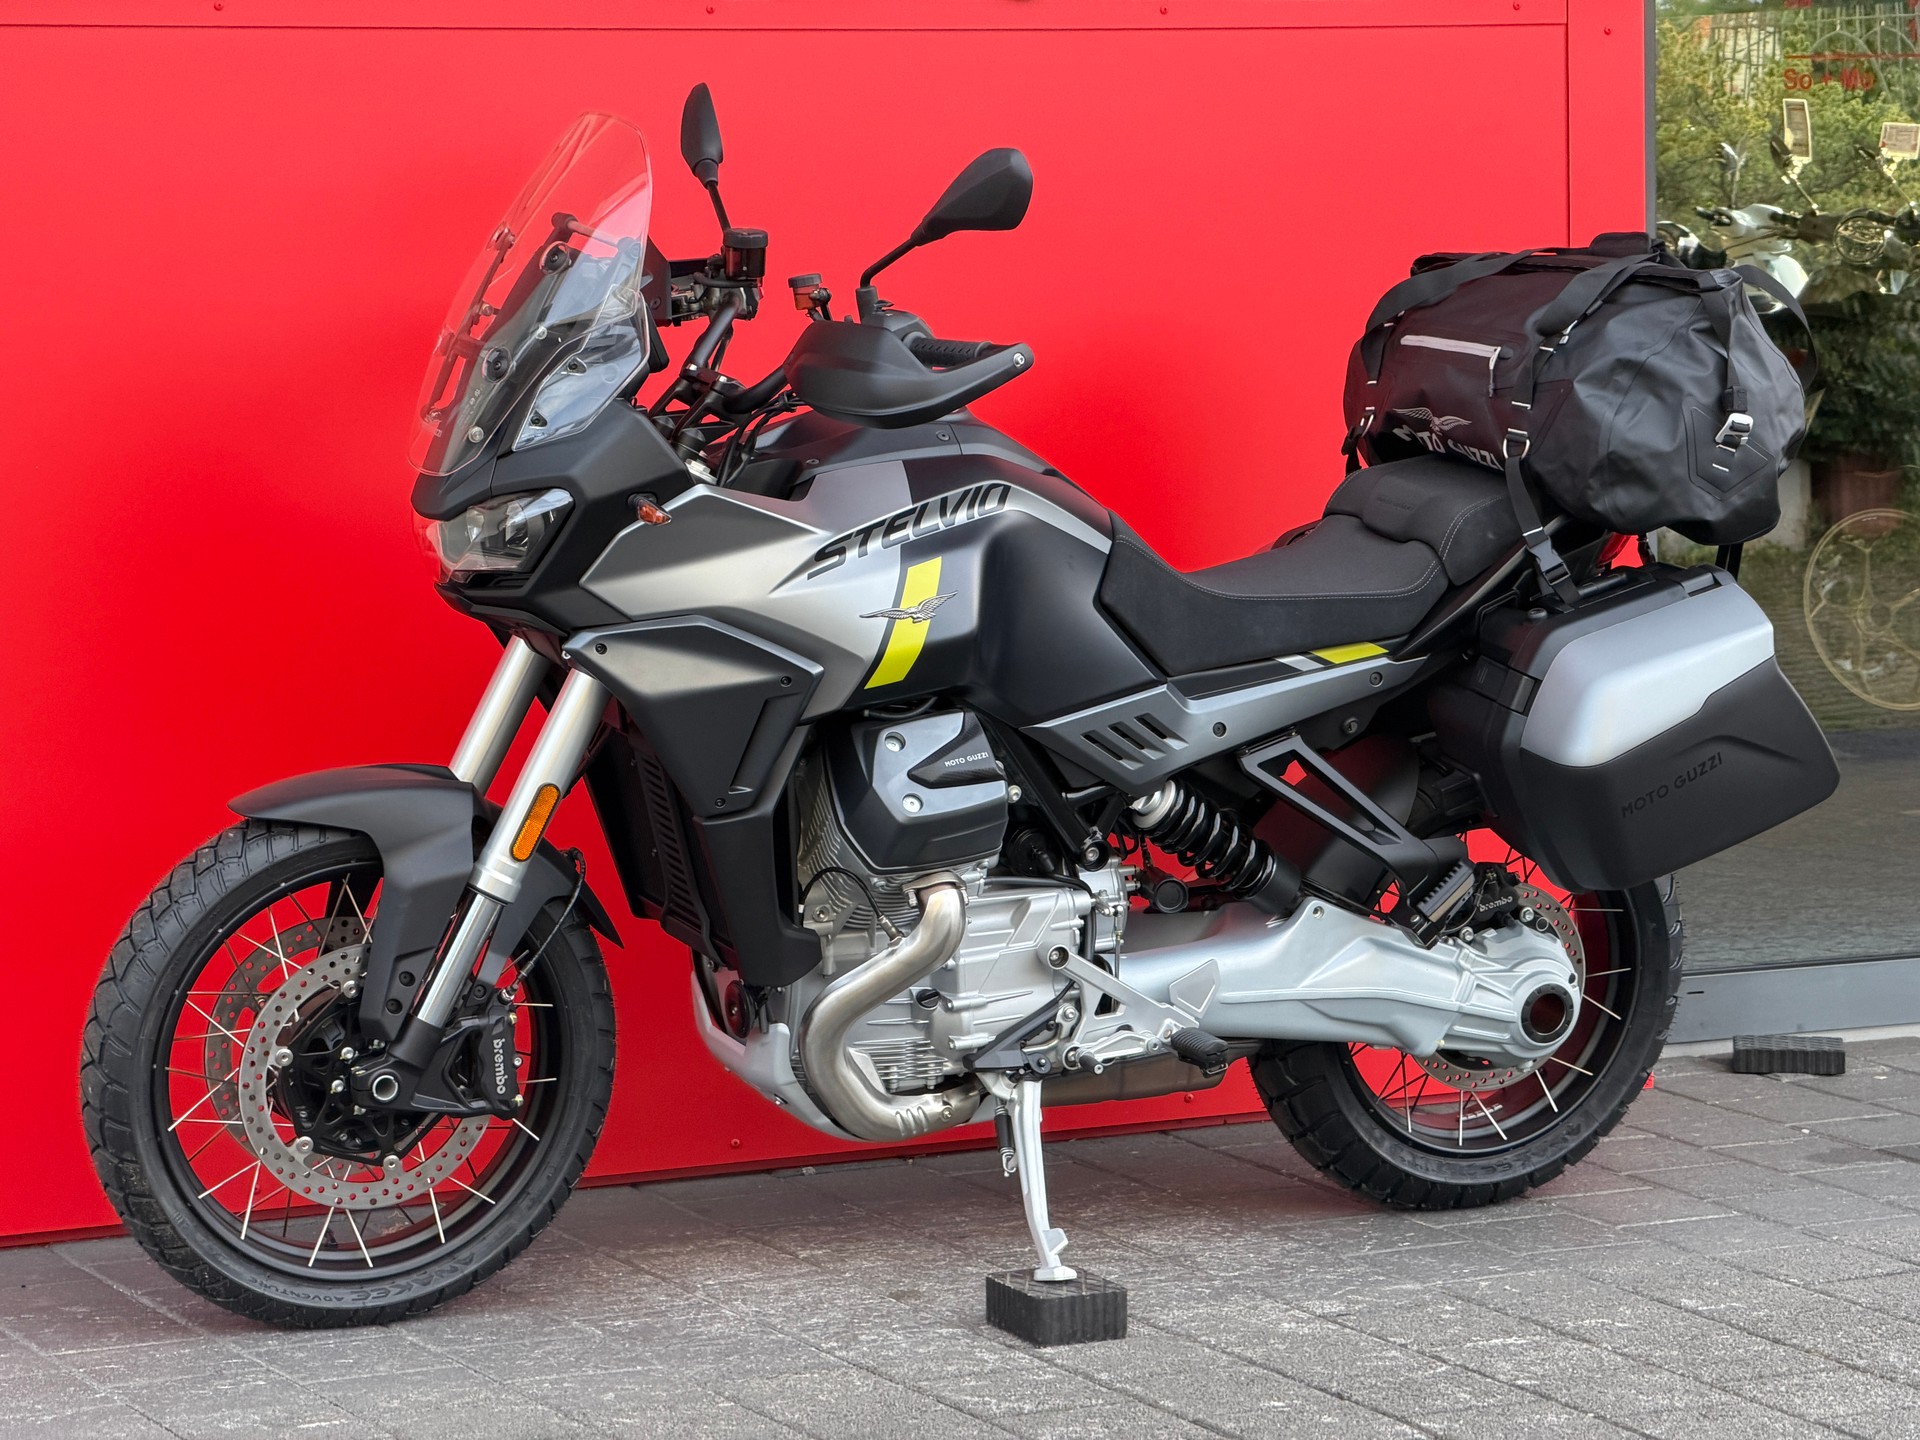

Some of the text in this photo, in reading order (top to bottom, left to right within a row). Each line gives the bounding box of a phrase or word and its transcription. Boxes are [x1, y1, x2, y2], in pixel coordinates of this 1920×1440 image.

[1783, 68, 1813, 90] So
[807, 483, 1012, 580] STELVIO
[944, 751, 989, 768] MOTO GUZZI
[1621, 752, 1722, 818] MOTO GUZZI
[1479, 896, 1513, 912] brembo
[493, 1038, 508, 1095] brembo
[349, 1251, 475, 1302] ANAKEE
